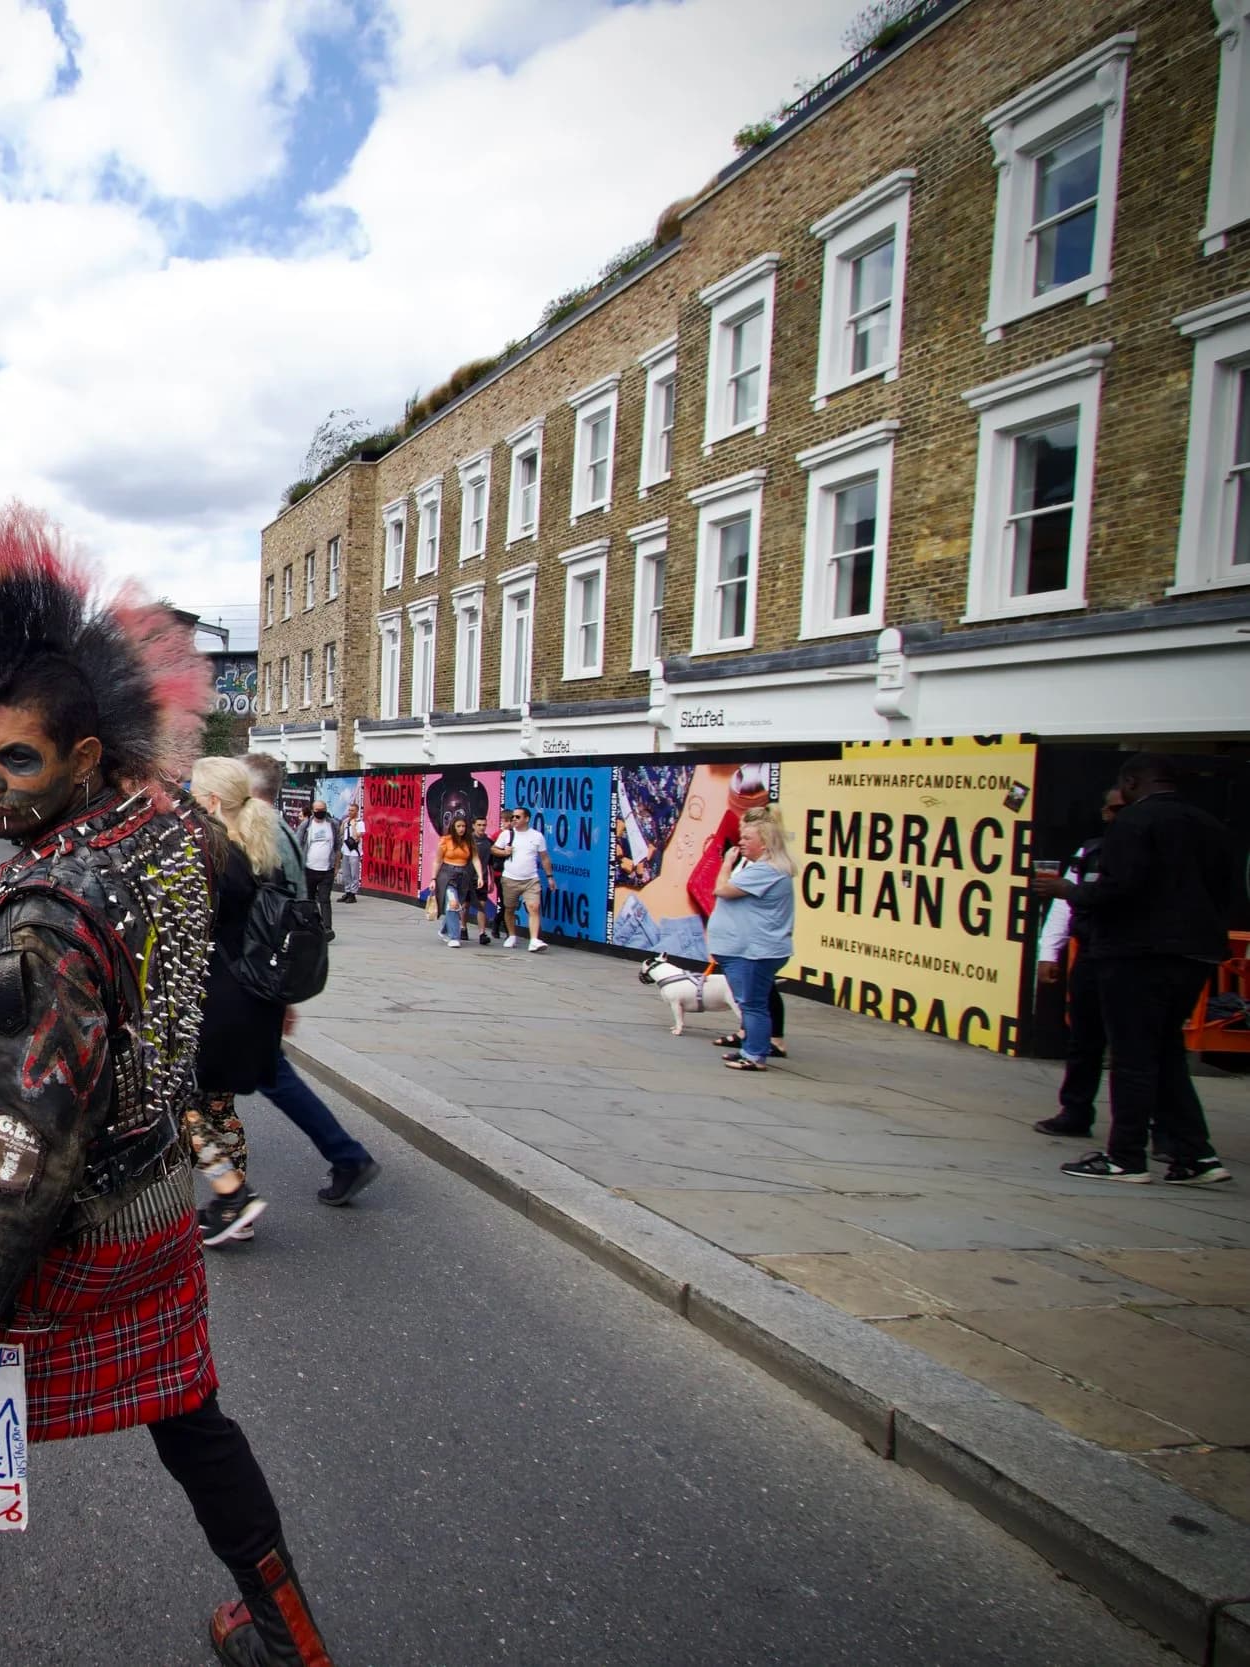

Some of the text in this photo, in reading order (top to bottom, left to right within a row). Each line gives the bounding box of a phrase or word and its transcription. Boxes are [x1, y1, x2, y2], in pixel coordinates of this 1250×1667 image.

[369, 782, 415, 809] CAMDEN
[515, 775, 594, 812] COMING
[770, 762, 780, 799] CAMDE
[828, 773, 1012, 790] HAWLEYWHARFCAMDEN.COM
[367, 834, 413, 865] ONLY IN
[532, 812, 593, 851] OON
[608, 793, 618, 900] HAWLEY WHARF CAMDEN
[805, 809, 1034, 877] EMBRACE
[367, 861, 412, 893] CAMDEN
[801, 861, 1030, 943] CHANGE
[820, 934, 998, 983] HAWLEYWHARFCAMDEN.COM
[13, 1426, 28, 1479] INSTAGRAM
